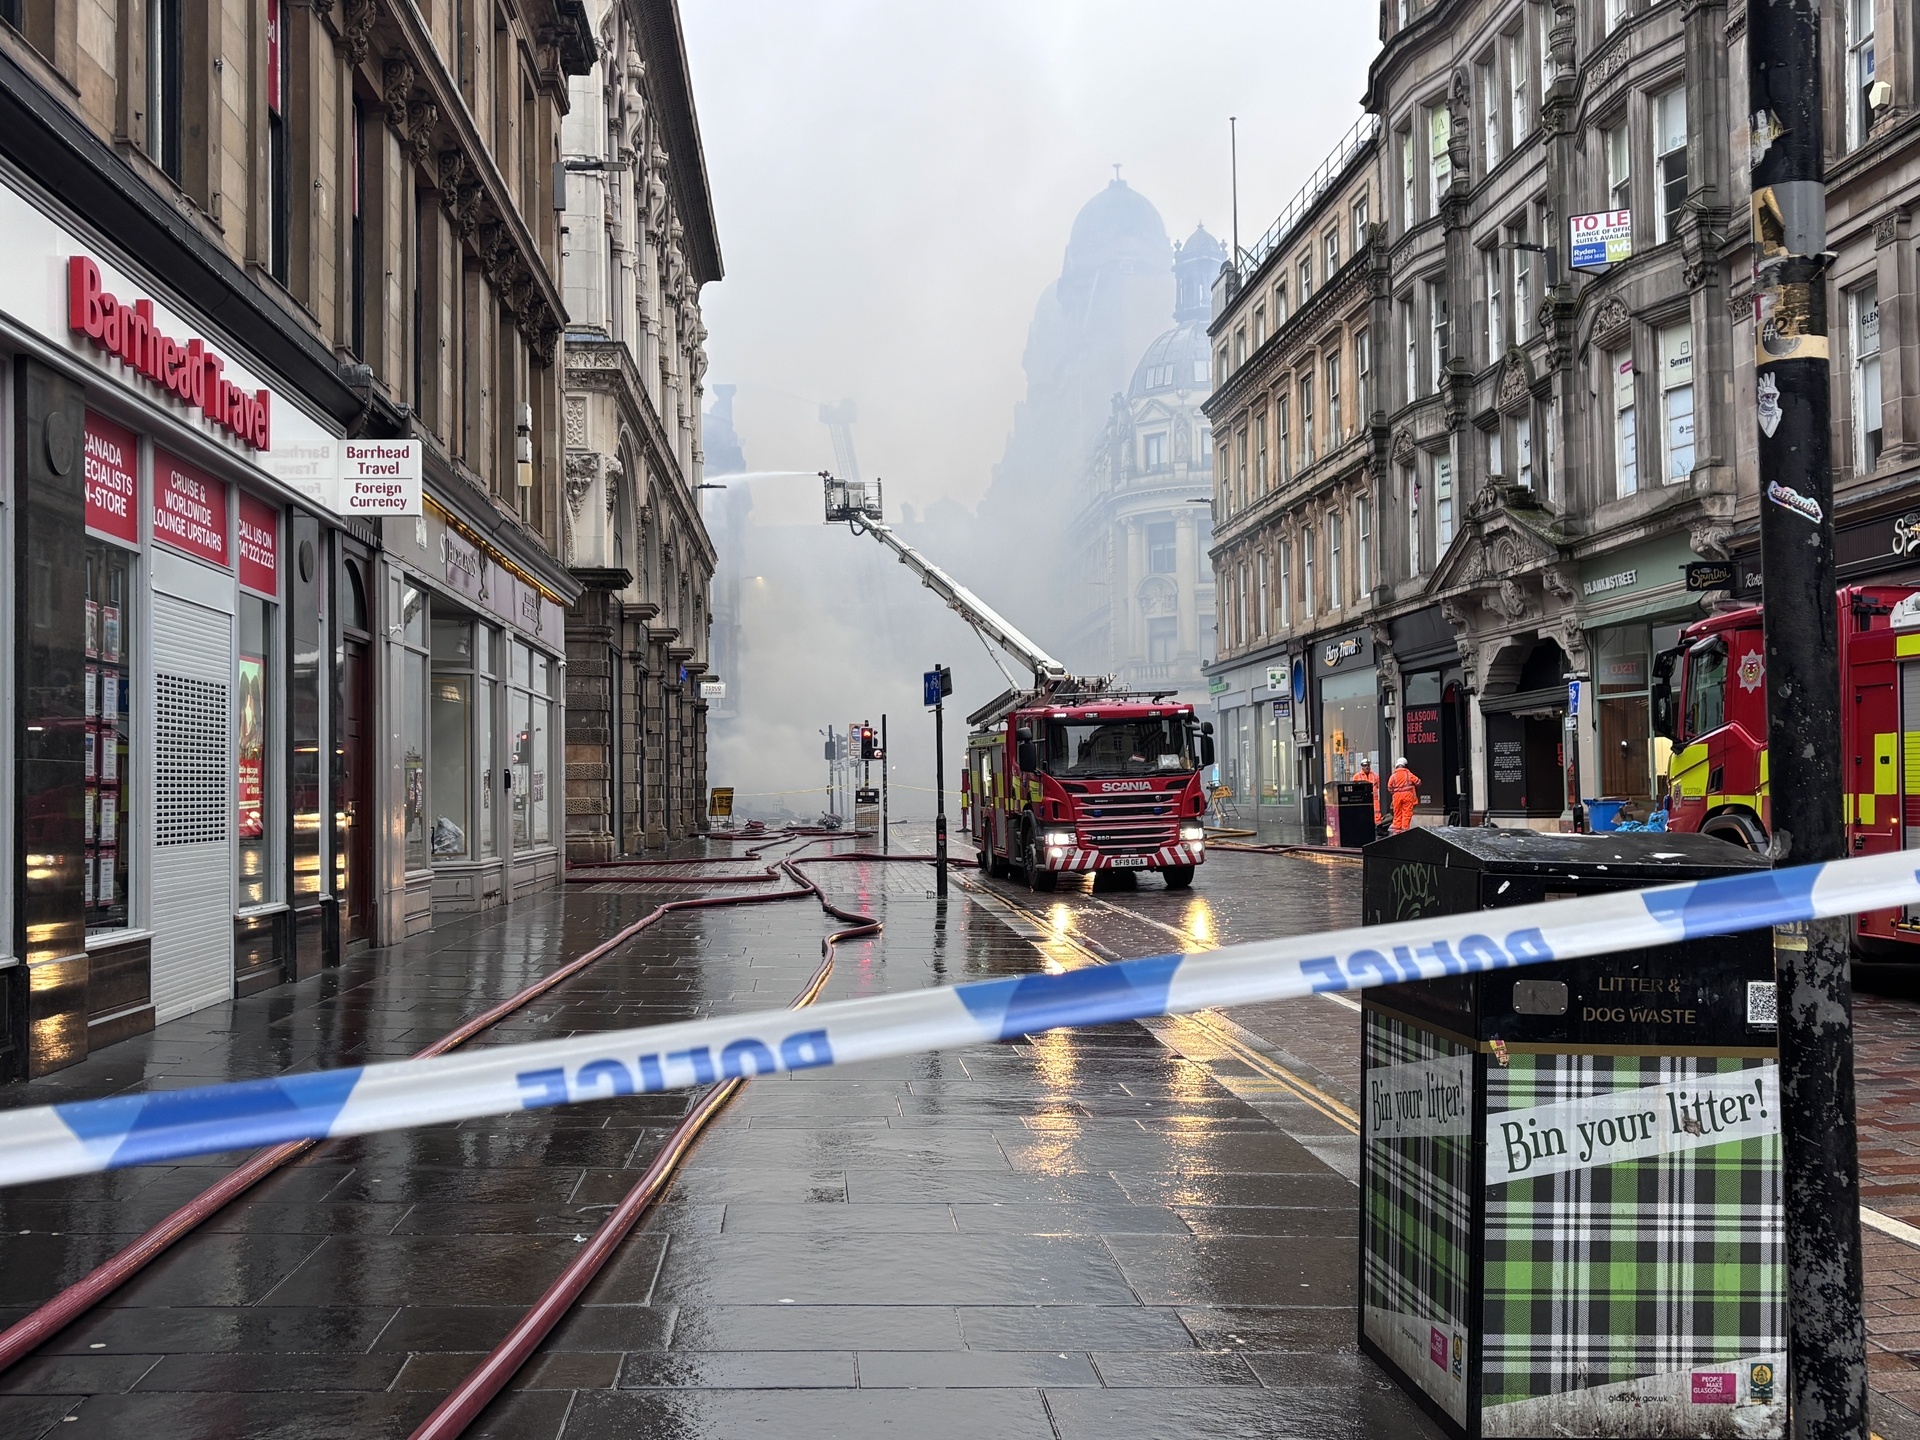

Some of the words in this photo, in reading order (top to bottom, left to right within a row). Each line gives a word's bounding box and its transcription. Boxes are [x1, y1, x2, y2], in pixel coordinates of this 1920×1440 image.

[1572, 215, 1598, 232] TO
[1605, 210, 1630, 228] LE
[1576, 230, 1600, 238] RANGE
[1576, 236, 1598, 245] SUITES
[1574, 248, 1596, 256] Ryden
[70, 256, 204, 407] Barrhead
[205, 352, 270, 452] Travel
[346, 445, 410, 459] Barrhead
[84, 458, 133, 496] ECIALISTS
[358, 461, 400, 475] Travel
[171, 470, 199, 499] CRUISE
[199, 485, 206, 503] &
[355, 482, 402, 497] Foreign
[84, 482, 127, 518] N-STORE
[164, 489, 212, 527] WORLDWIDE
[350, 496, 407, 511] Currency
[153, 505, 186, 538] LOUNGE
[187, 523, 222, 552] UPSTAIRS
[238, 518, 252, 541] CALL
[253, 528, 262, 544] US
[262, 533, 272, 550] ON
[238, 540, 249, 560] 141
[249, 546, 260, 564] 222
[261, 552, 275, 570] 2223
[1583, 577, 1607, 595] BLANK
[1609, 569, 1637, 589] STREET
[1689, 567, 1731, 588] Spuntini
[1340, 637, 1357, 658] Travel
[1406, 709, 1439, 722] GLASGOW,
[1406, 722, 1423, 733] HERE
[1407, 734, 1417, 744] WE
[1417, 732, 1439, 744] COME.
[1101, 781, 1152, 792] SCANIA
[1598, 976, 1663, 993] LITTER
[1667, 976, 1681, 993] &
[1583, 1006, 1626, 1023] DOG
[1630, 1007, 1696, 1024] WASTE
[1372, 1079, 1393, 1132] Bin
[1395, 1088, 1423, 1133] your
[1426, 1069, 1465, 1124] litter!
[1500, 1117, 1567, 1174] Bin
[1576, 1108, 1656, 1162] your
[1666, 1078, 1768, 1136] litter!
[1608, 1393, 1668, 1403] glasgow.gov.uk
